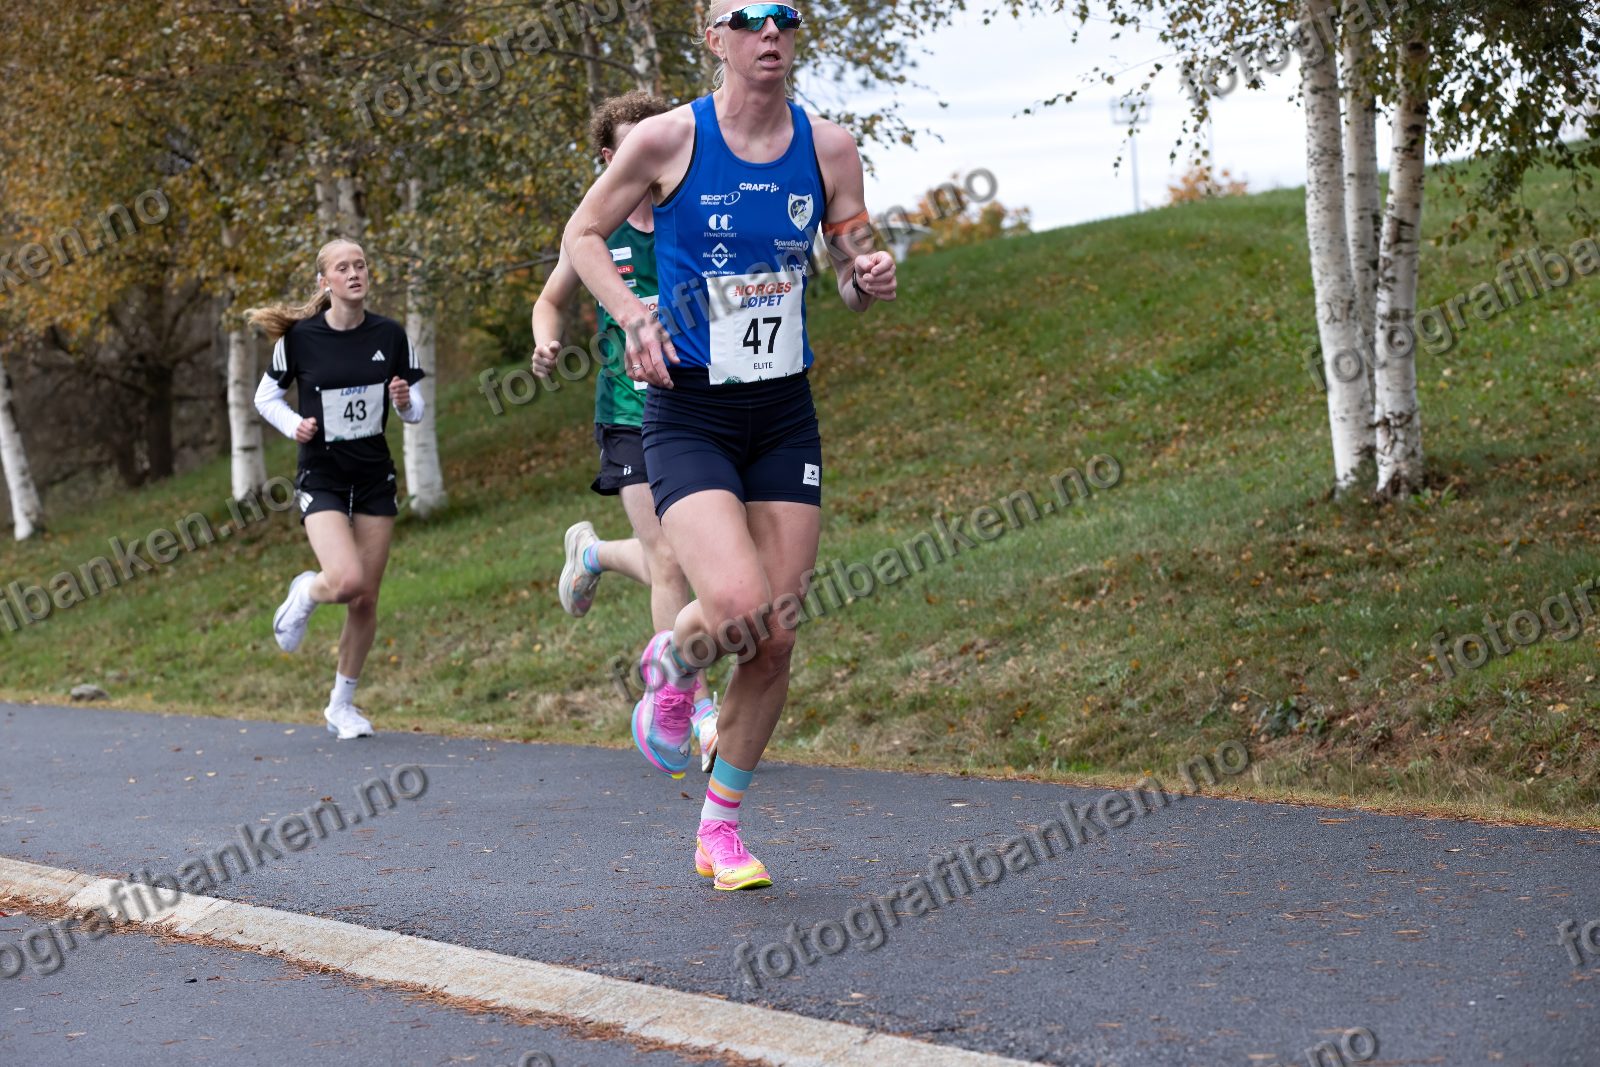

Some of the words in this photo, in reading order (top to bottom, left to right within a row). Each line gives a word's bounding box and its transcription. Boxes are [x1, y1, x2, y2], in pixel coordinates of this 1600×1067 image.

[739, 182, 770, 192] CRAFT
[735, 281, 791, 297] NORGES
[740, 294, 784, 308] LØPET
[742, 316, 782, 355] 47
[753, 361, 773, 370] ELITE
[343, 399, 367, 423] 43
